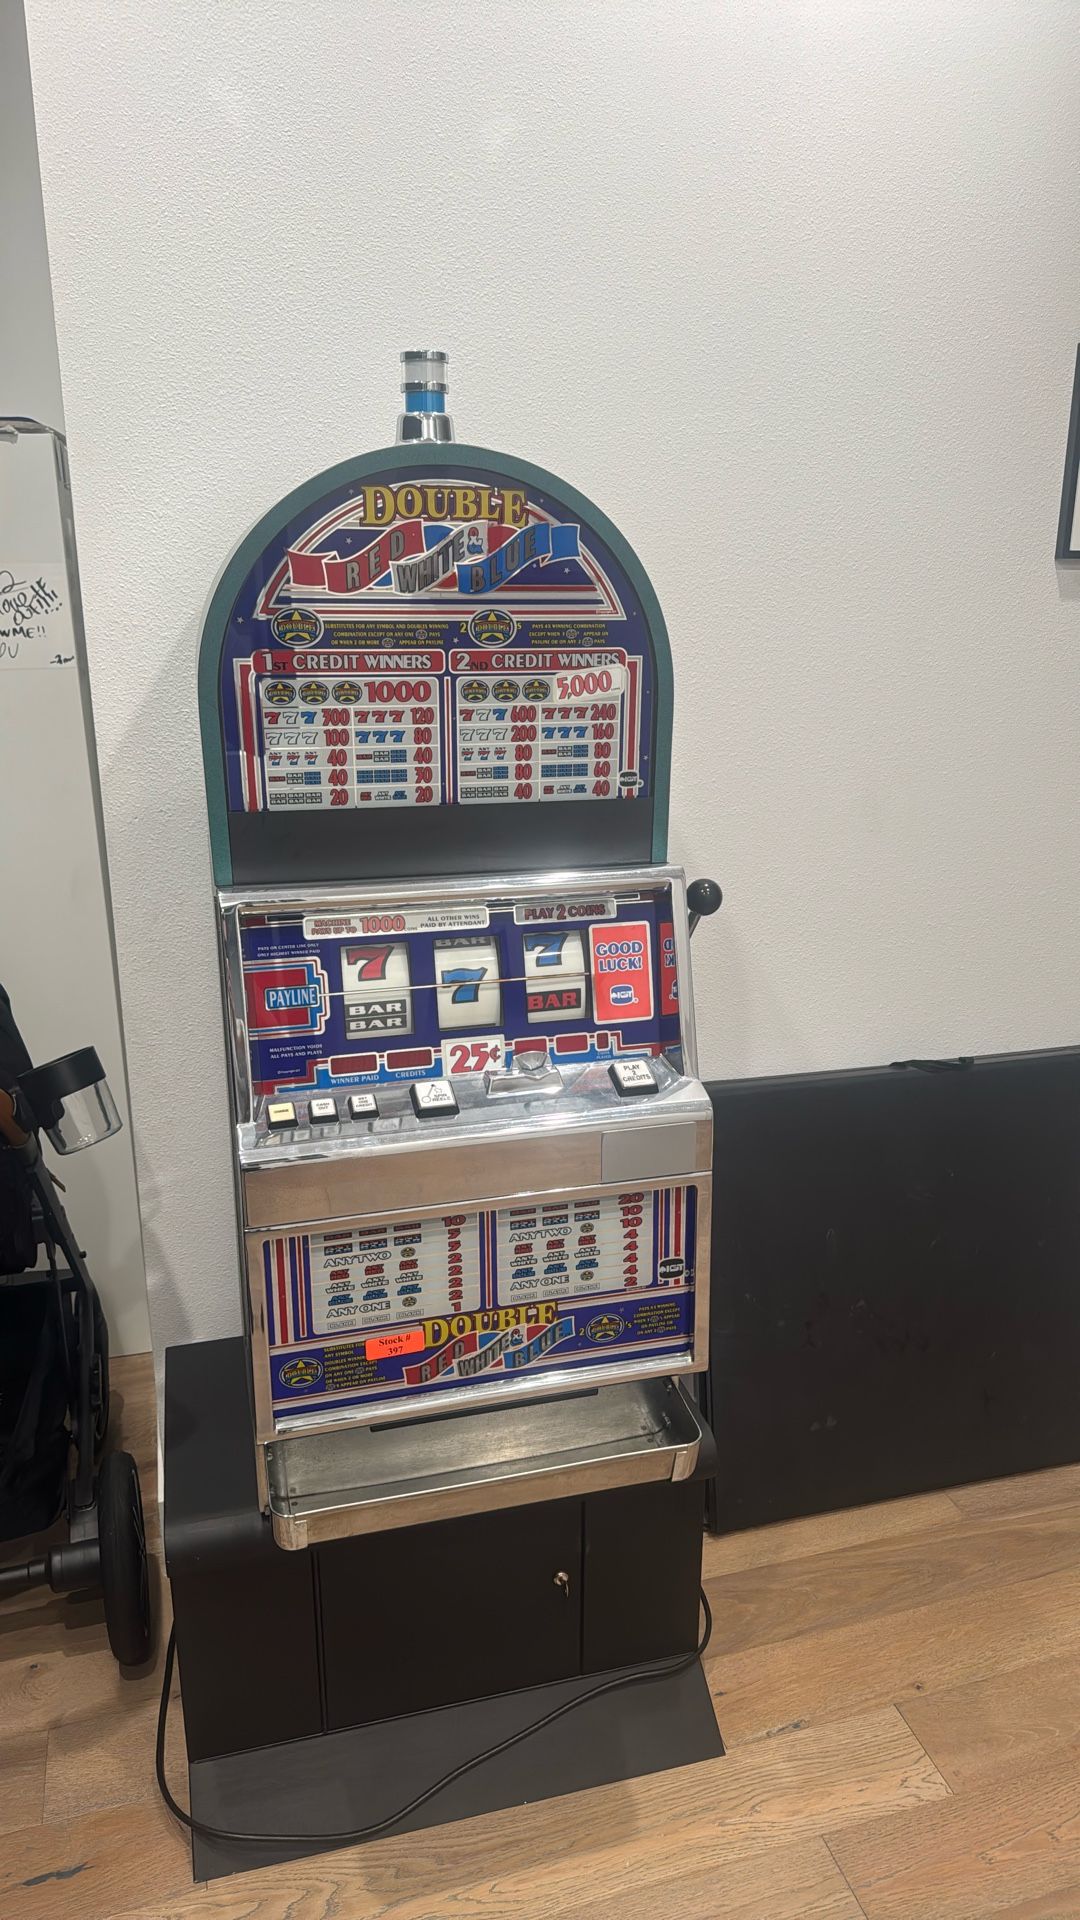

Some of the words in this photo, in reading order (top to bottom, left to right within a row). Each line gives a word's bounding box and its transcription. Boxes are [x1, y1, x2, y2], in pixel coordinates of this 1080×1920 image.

[360, 484, 529, 527] DOUBLE
[467, 526, 484, 554] &
[345, 529, 405, 592] RED
[396, 528, 465, 594] WHITE
[471, 525, 537, 593] BLUE
[292, 654, 359, 670] CREDIT
[363, 654, 431, 670] WINNERS
[491, 653, 553, 669] CREDIT
[557, 652, 620, 668] WINNERS
[364, 680, 432, 703] 1000
[557, 670, 612, 700] 5,000
[322, 708, 351, 726] 300
[410, 707, 435, 725] 120
[511, 705, 537, 723] 600
[591, 704, 616, 721] 240
[324, 729, 350, 747] 100
[414, 727, 432, 745] 80
[511, 725, 537, 742] 200
[592, 723, 615, 740] 160
[327, 749, 348, 766] 40
[413, 747, 433, 764] 40
[514, 744, 533, 762] 80
[594, 742, 611, 759] 80
[328, 769, 349, 786] 40
[415, 766, 433, 784] 30
[514, 763, 533, 781] 80
[594, 761, 611, 778] 60
[415, 786, 434, 803] 20
[514, 783, 533, 800] 40
[592, 780, 611, 797] 40
[330, 789, 349, 806] 20
[524, 908, 554, 921] PLAY
[556, 904, 567, 921] 2
[568, 904, 606, 917] COINS
[311, 928, 332, 936] PAYS
[333, 927, 344, 935] UP
[345, 926, 358, 934] TO
[314, 919, 351, 928] MACHINE
[359, 915, 406, 934] 1000
[448, 919, 486, 927] ATTENDANT
[524, 932, 569, 967] 7
[595, 942, 643, 956] GOOD
[346, 945, 395, 982] 7
[599, 957, 642, 972] LUCK!
[441, 966, 488, 1004] 7
[269, 988, 316, 1008] PAYLINE
[528, 992, 577, 1010] BAR
[349, 1003, 402, 1016] BAR
[350, 1019, 402, 1030] BAR
[450, 1043, 501, 1074] 25¢
[331, 1076, 360, 1085] WINNER
[362, 1074, 380, 1082] PAID
[395, 1070, 426, 1079] CREDITS
[623, 1074, 652, 1082] CREDITS
[618, 1193, 645, 1205] 20
[620, 1205, 643, 1217] 10
[442, 1215, 467, 1228] 10
[620, 1217, 643, 1228] 10
[624, 1229, 639, 1240] 4
[624, 1241, 639, 1252] 4
[448, 1253, 463, 1265] 2
[624, 1253, 639, 1263] 4
[448, 1265, 463, 1277] 2
[624, 1265, 639, 1275] 4
[449, 1277, 463, 1289] 2
[510, 1279, 540, 1291] ANY
[540, 1275, 570, 1286] ONE
[624, 1276, 638, 1287] 2
[449, 1290, 464, 1301] 2
[327, 1306, 359, 1319] ANY
[359, 1301, 391, 1313] ONE
[451, 1302, 462, 1312] 1
[422, 1302, 558, 1348] DOUBLE
[379, 1336, 404, 1347] Stock
[405, 1334, 411, 1342] #
[511, 1329, 524, 1345] &
[388, 1346, 404, 1356] 397
[514, 1325, 564, 1368] BLUE
[421, 1340, 465, 1383] RED
[458, 1337, 511, 1377] WHITE
